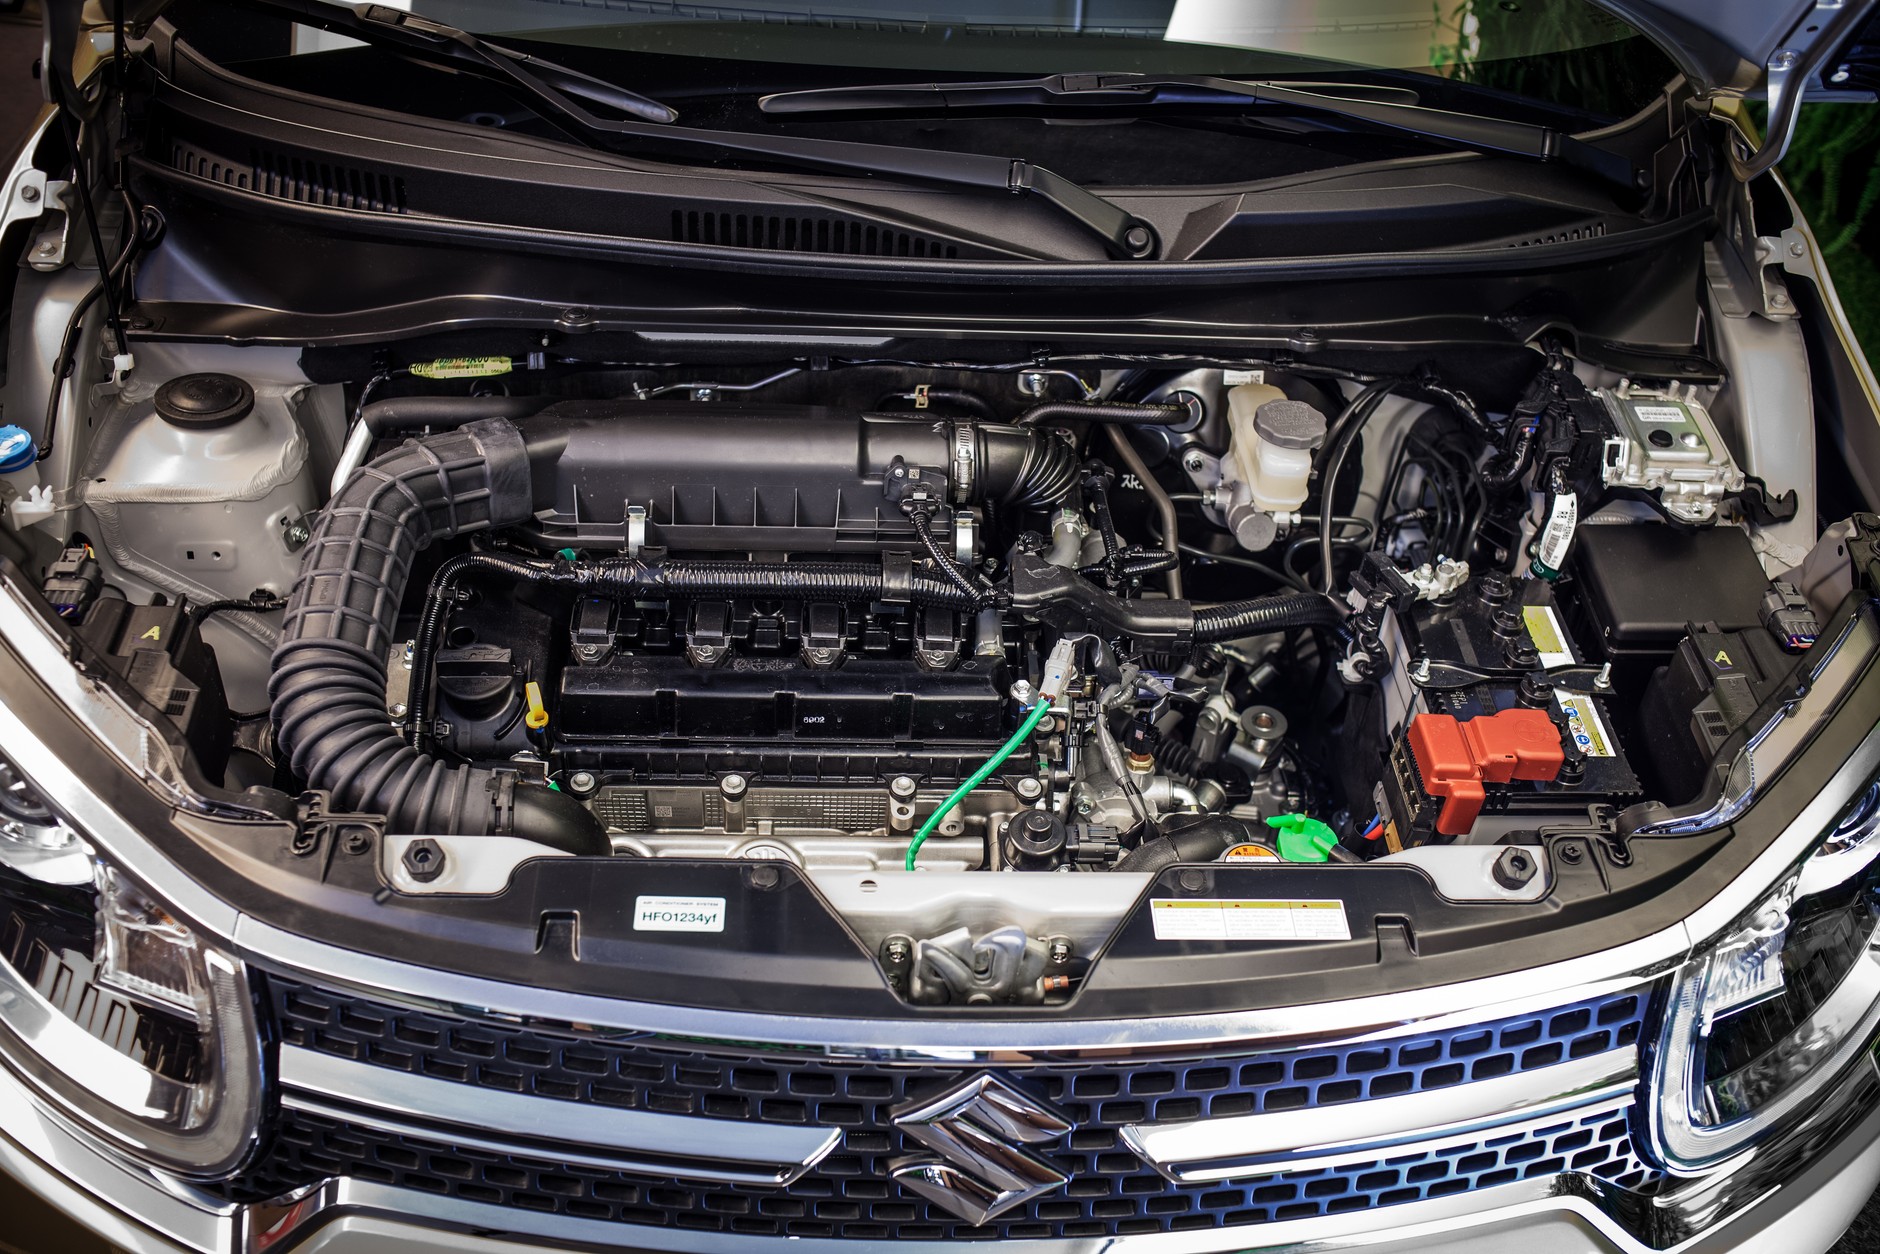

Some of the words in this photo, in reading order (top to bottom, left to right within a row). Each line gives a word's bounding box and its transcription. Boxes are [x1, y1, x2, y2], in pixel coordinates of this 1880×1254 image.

[140, 625, 160, 641] A
[1714, 650, 1733, 666] A
[642, 911, 718, 925] HFO1234yf
